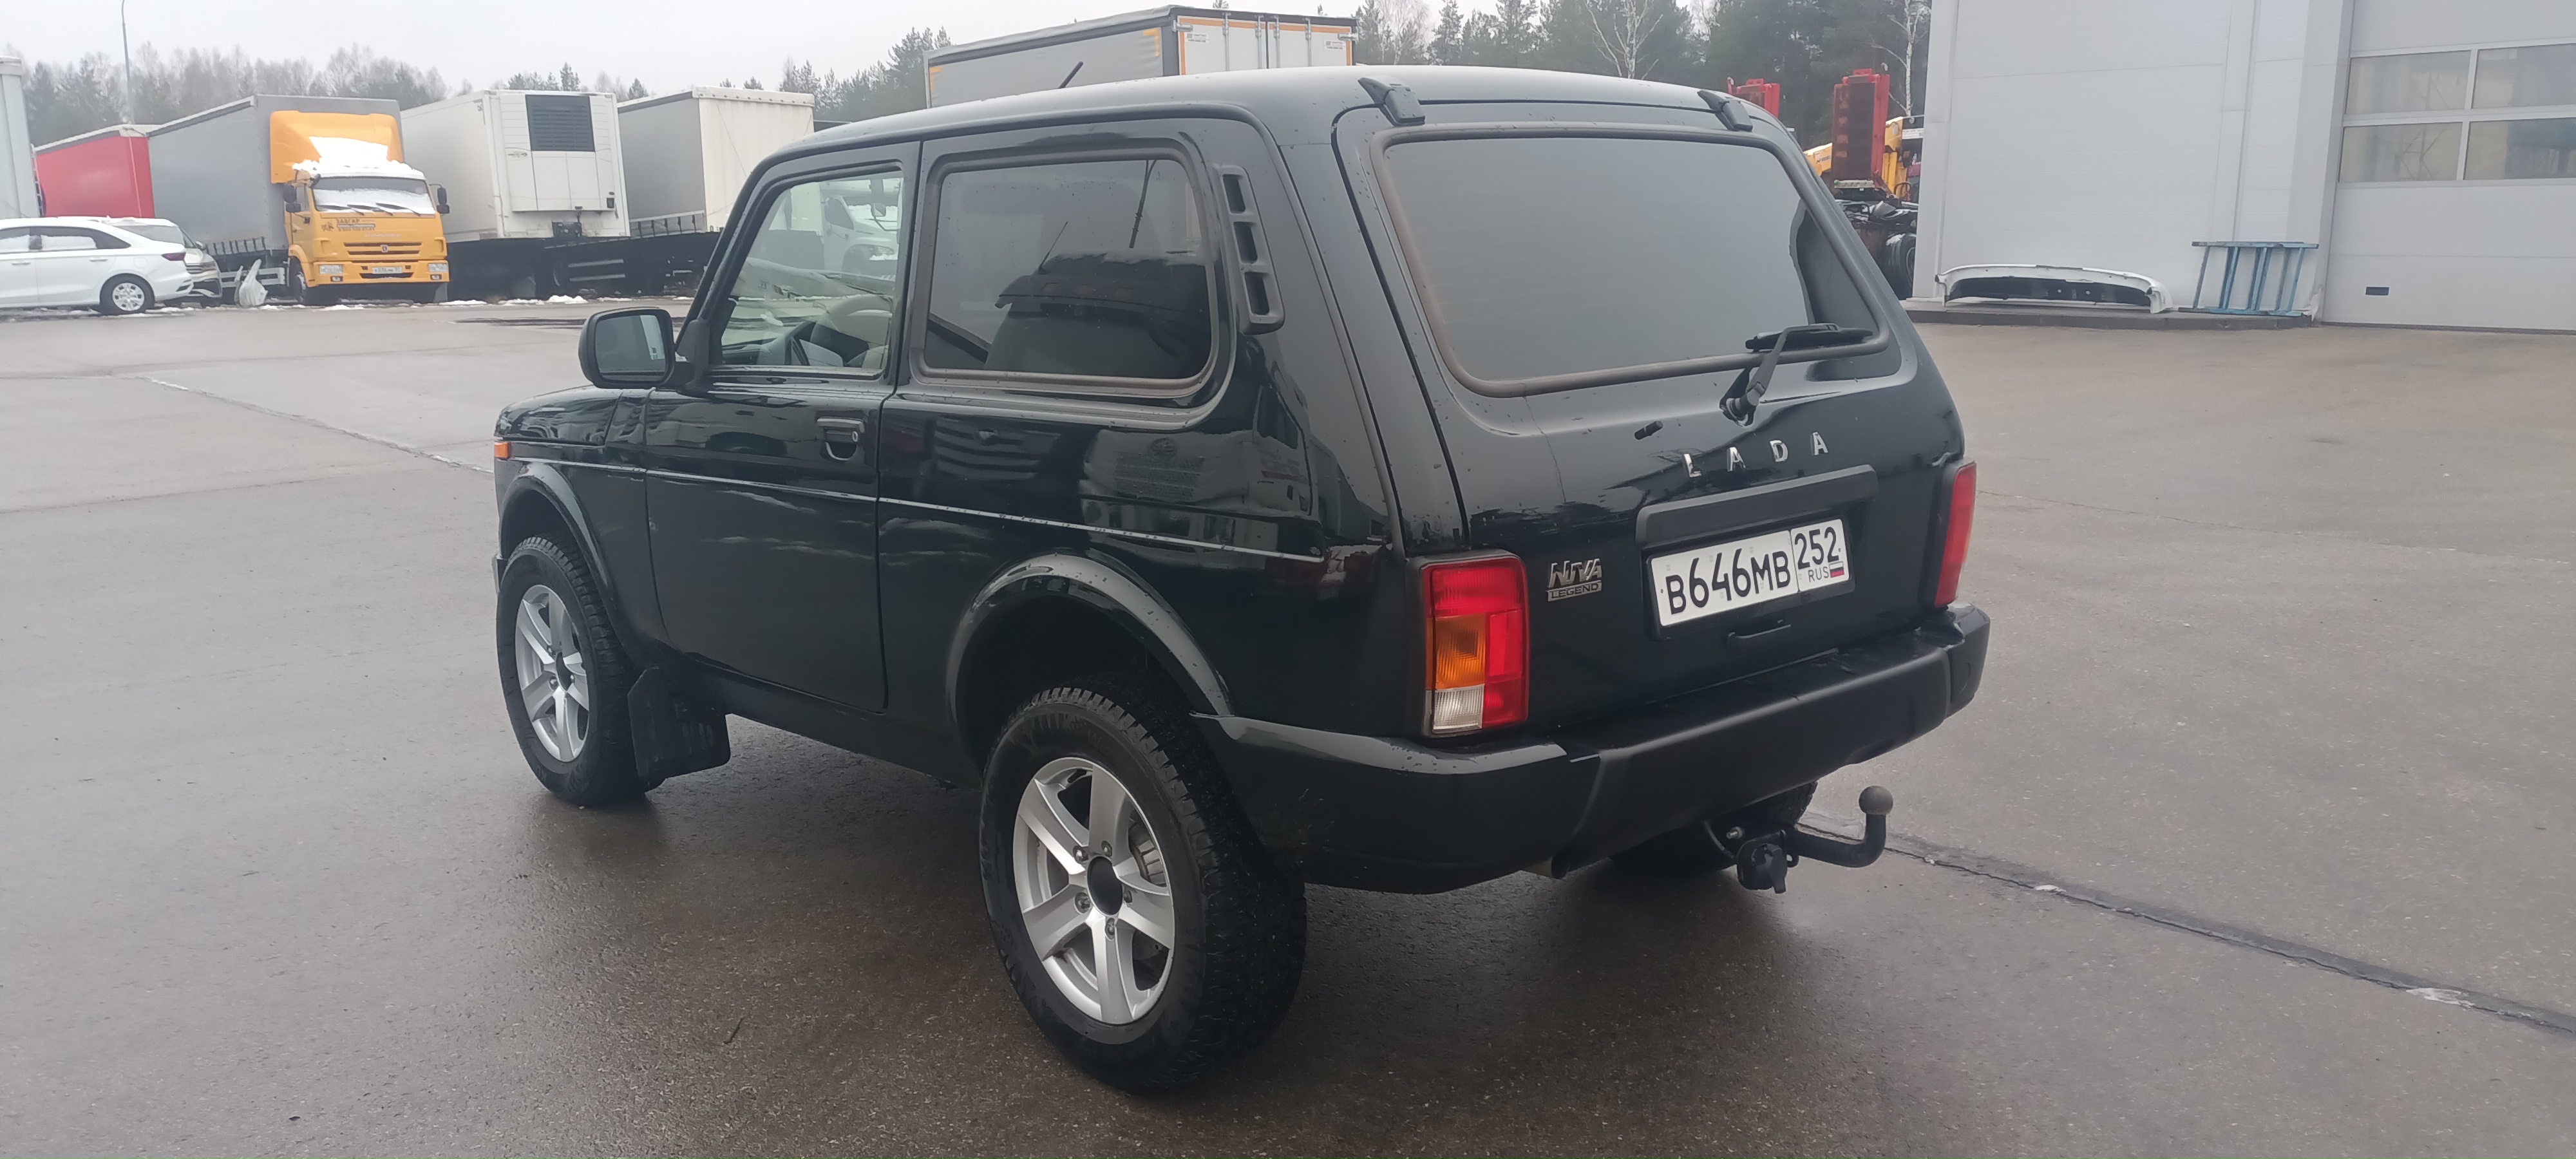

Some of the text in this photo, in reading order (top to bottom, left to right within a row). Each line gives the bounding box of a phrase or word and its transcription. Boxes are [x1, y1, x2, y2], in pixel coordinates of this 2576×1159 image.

[1683, 432, 1828, 477] LADA
[1795, 527, 1839, 569] 252
[1548, 558, 1602, 589] NIVA
[1808, 566, 1829, 582] RUS
[1551, 583, 1599, 599] LEGEND
